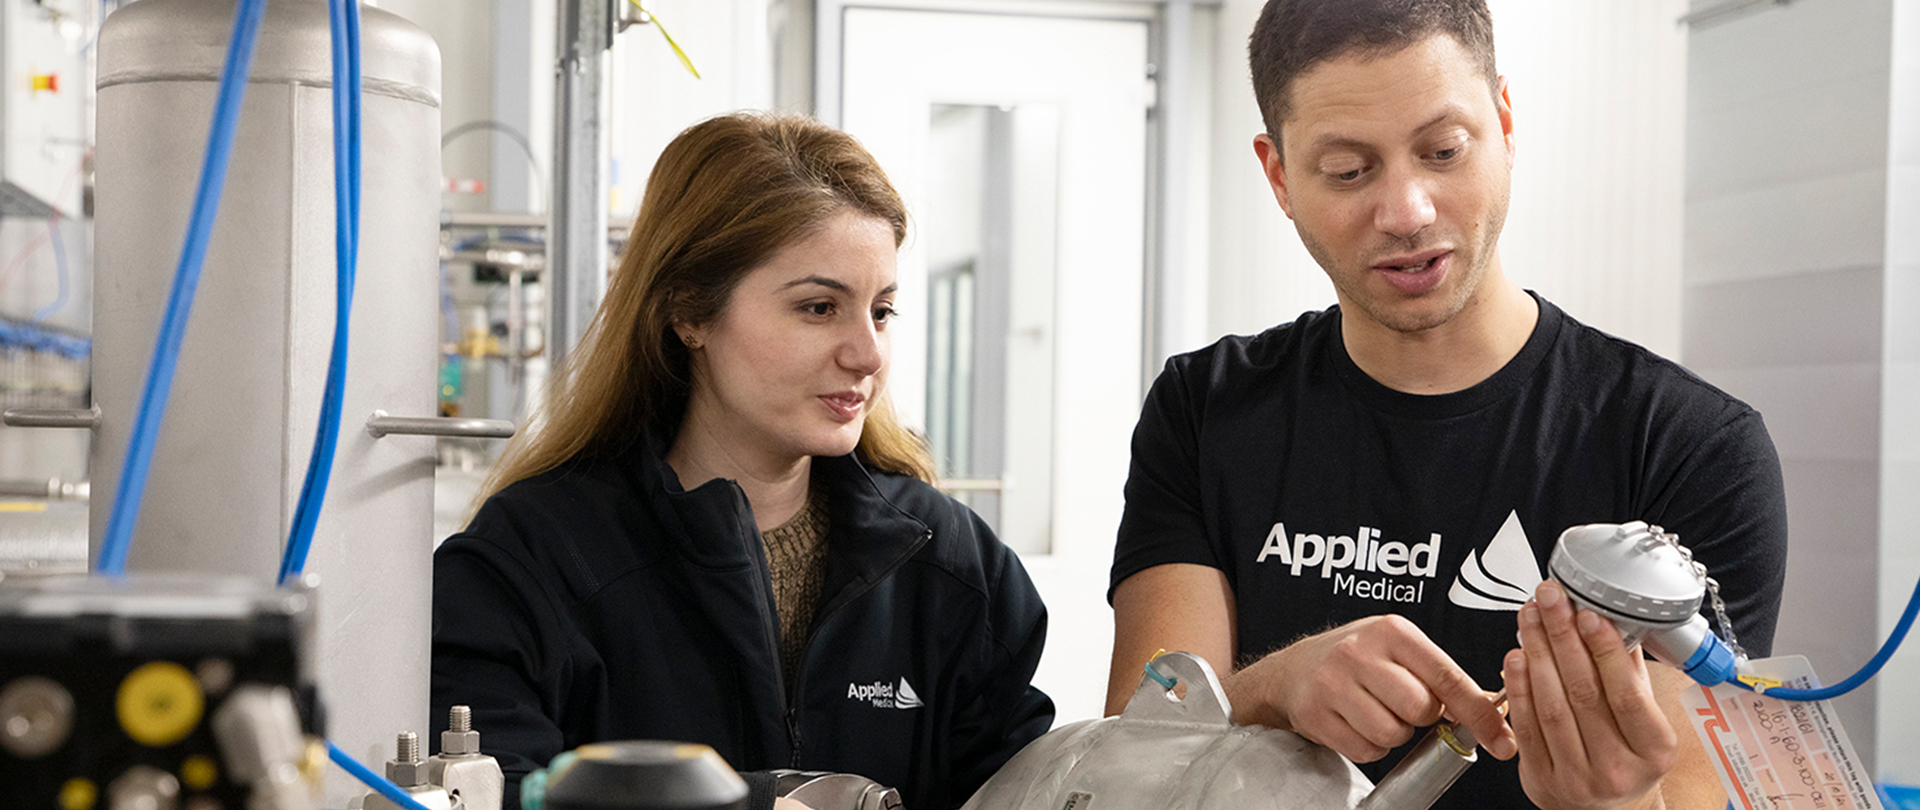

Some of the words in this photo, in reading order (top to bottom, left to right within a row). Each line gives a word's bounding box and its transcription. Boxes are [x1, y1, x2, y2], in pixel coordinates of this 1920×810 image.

[1256, 522, 1442, 579] Applied
[1333, 573, 1424, 603] Medical
[847, 681, 893, 701] Applied
